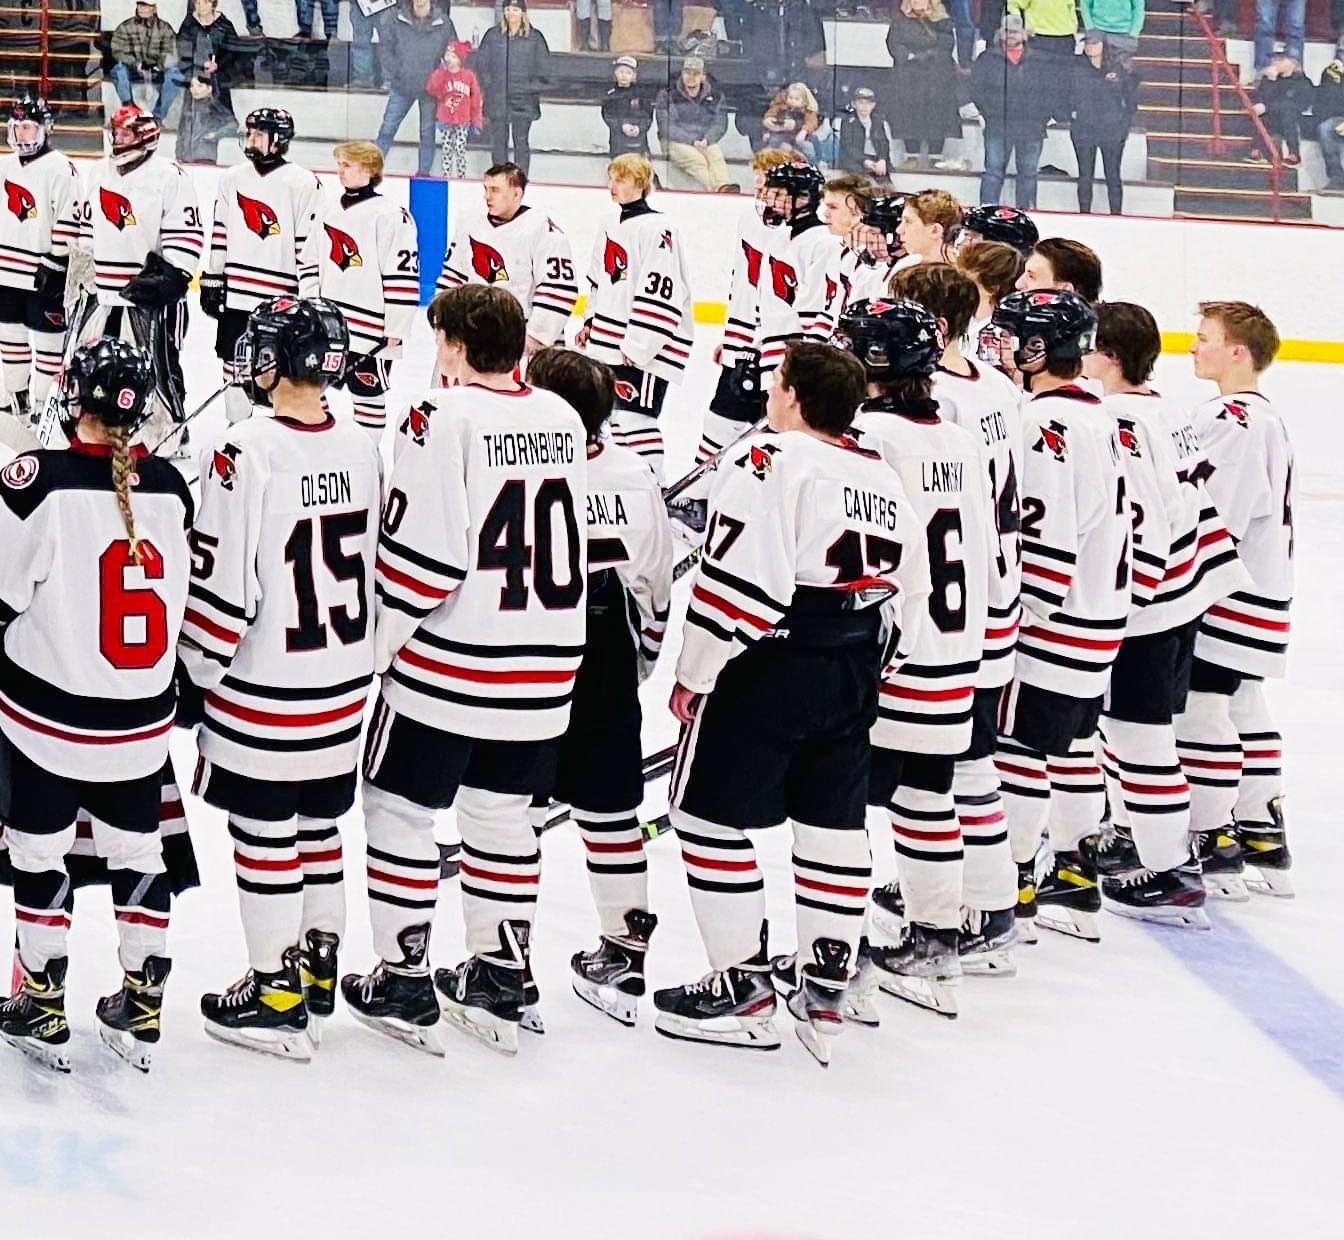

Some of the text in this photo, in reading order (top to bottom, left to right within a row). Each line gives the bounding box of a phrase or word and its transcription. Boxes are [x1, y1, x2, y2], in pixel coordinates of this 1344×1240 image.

[547, 257, 575, 281] 35
[644, 271, 674, 300] 38
[323, 352, 344, 372] 15
[117, 388, 136, 410] 6
[300, 470, 353, 508] OLSON
[844, 486, 898, 532] CAVERS
[477, 476, 585, 611] 40
[283, 509, 369, 654] 15
[926, 507, 967, 634] 6
[98, 539, 169, 670] 6
